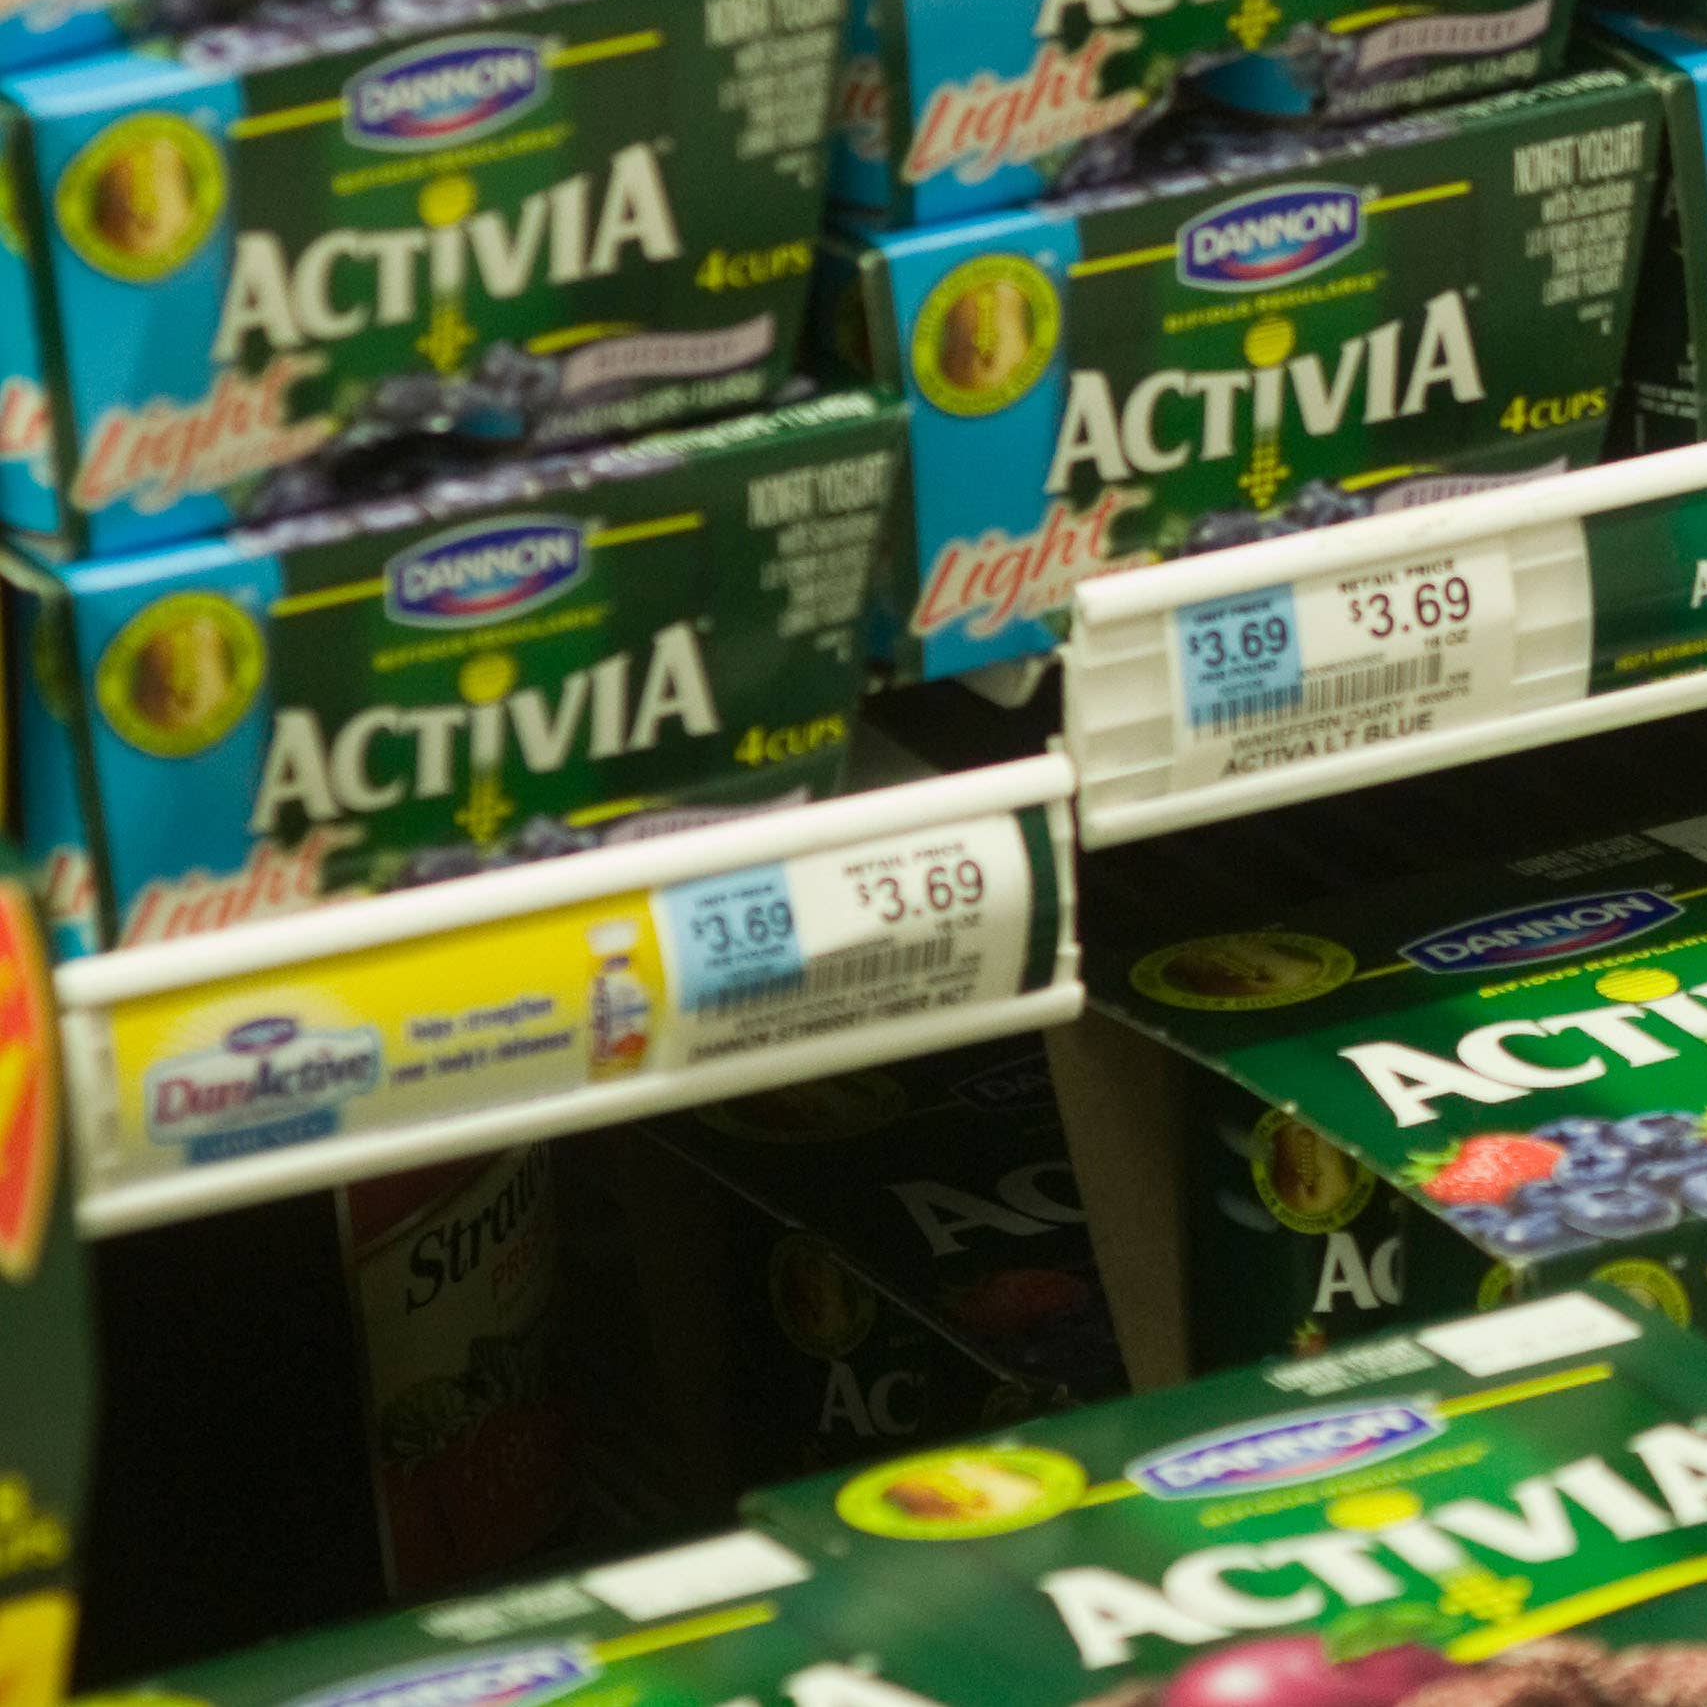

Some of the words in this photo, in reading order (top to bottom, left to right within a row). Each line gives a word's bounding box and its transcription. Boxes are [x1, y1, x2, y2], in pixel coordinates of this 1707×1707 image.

[1045, 290, 1488, 494] ACTIVIA
[1350, 576, 1470, 639] $3.69
[247, 620, 719, 837] ACTIVIA
[1363, 710, 1433, 744] BLUE
[853, 858, 985, 926] $3.69
[1421, 893, 1646, 968] DANNON
